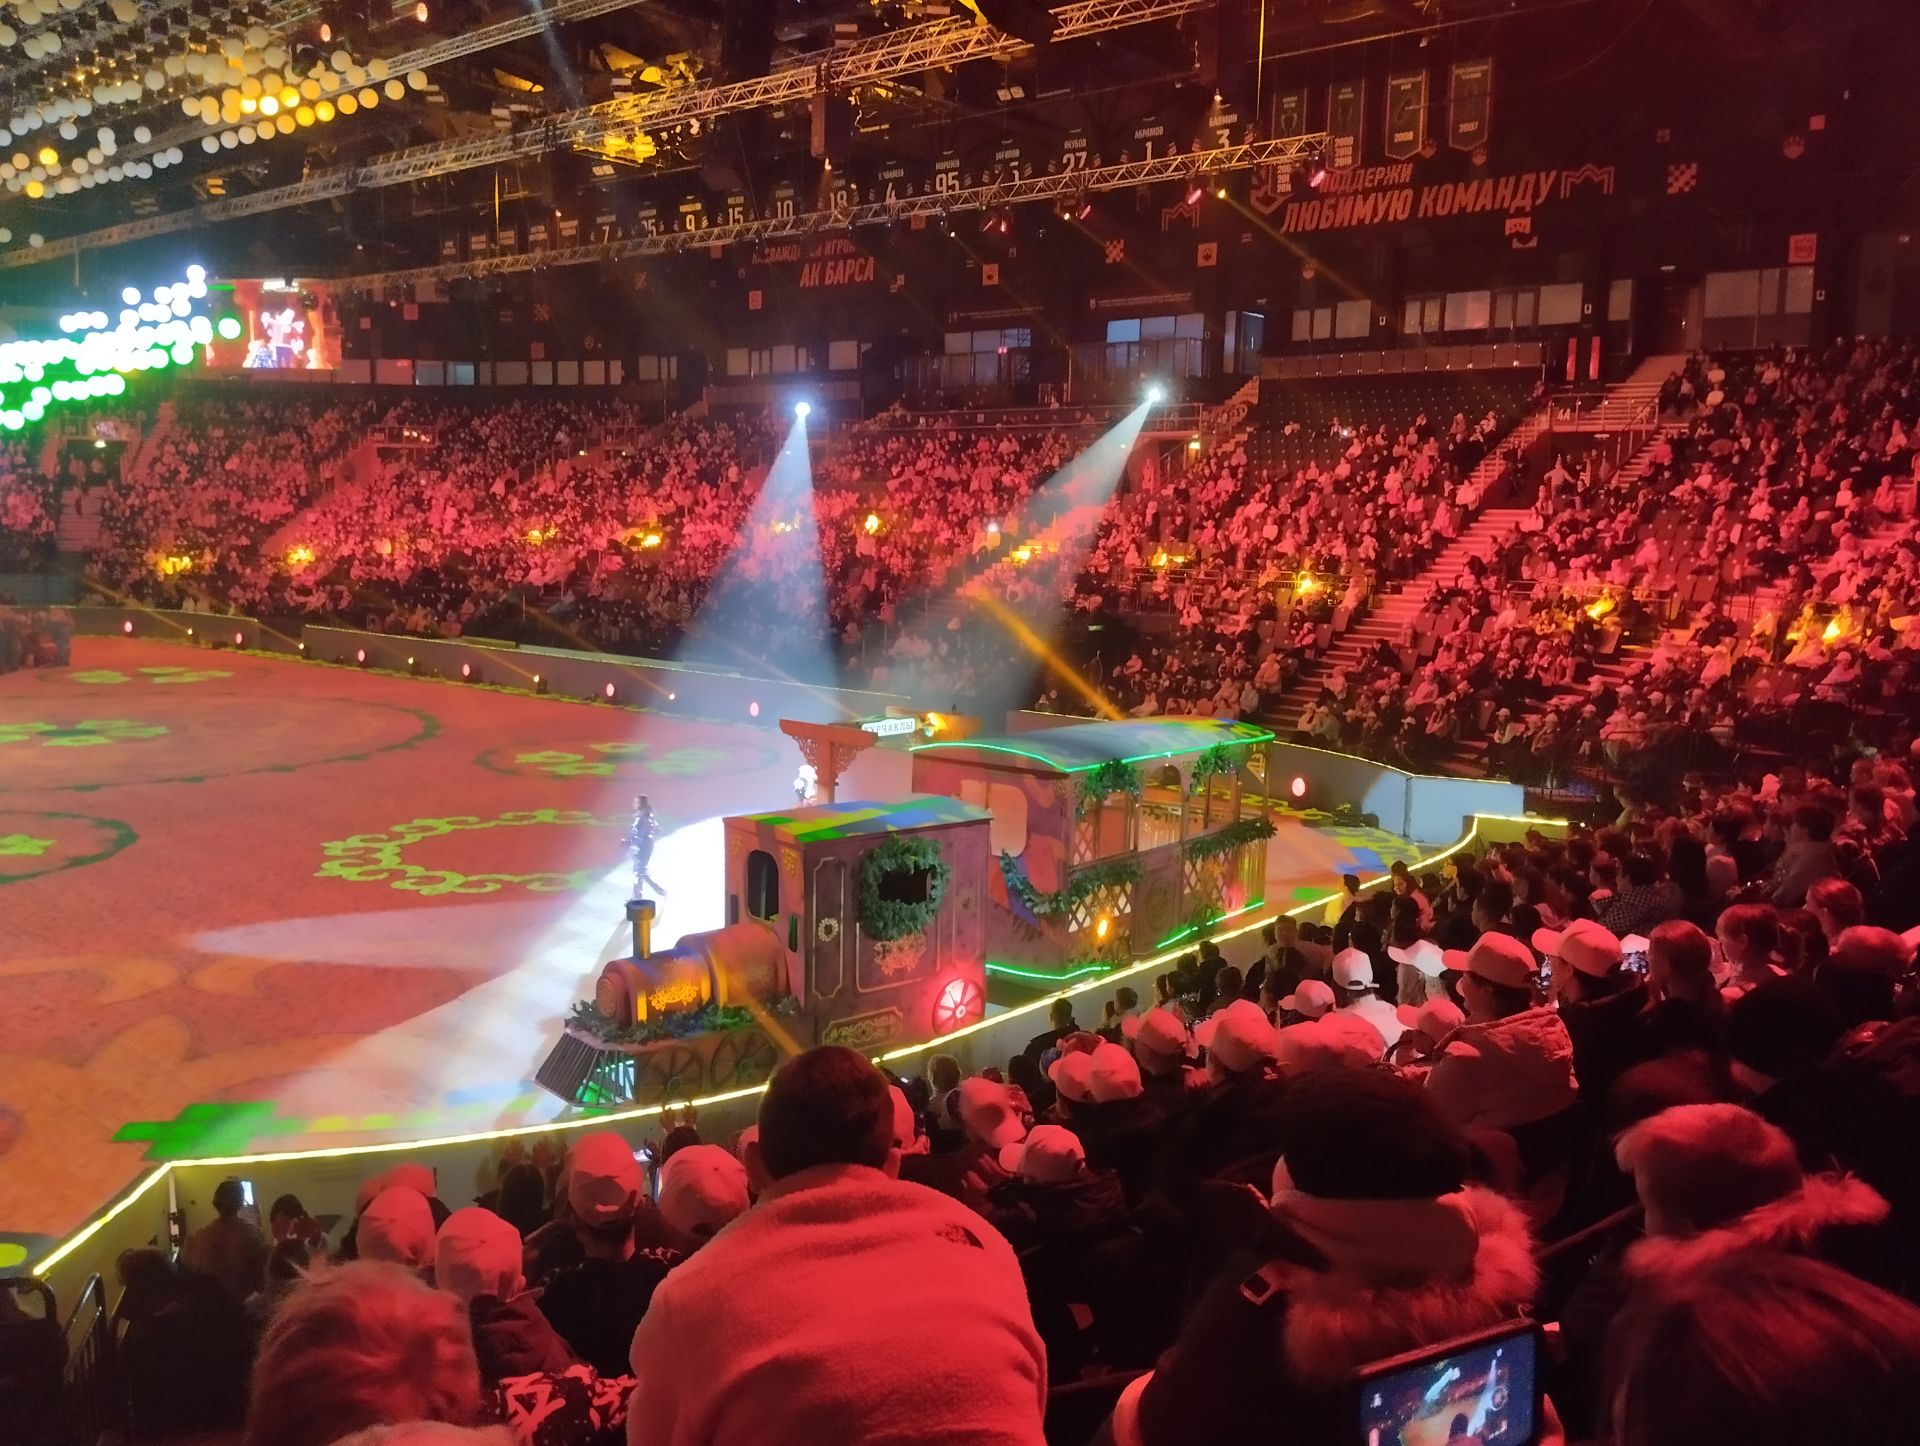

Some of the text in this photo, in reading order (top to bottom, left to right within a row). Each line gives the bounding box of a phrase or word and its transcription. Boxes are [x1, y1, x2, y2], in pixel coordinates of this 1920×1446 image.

[1134, 126, 1164, 140] АБРАМОВ
[1217, 129, 1230, 149] 3
[1145, 141, 1153, 161] 1
[935, 158, 960, 171] МОРОЗОВ
[1062, 151, 1088, 176] 27
[935, 171, 960, 196] 95
[1318, 163, 1413, 194] ПОДДЕРЖИ
[1281, 170, 1558, 233] ЛЮБИМУЮ КОМАНДУ
[728, 207, 744, 226] 15
[800, 256, 874, 287] АК БАРСА
